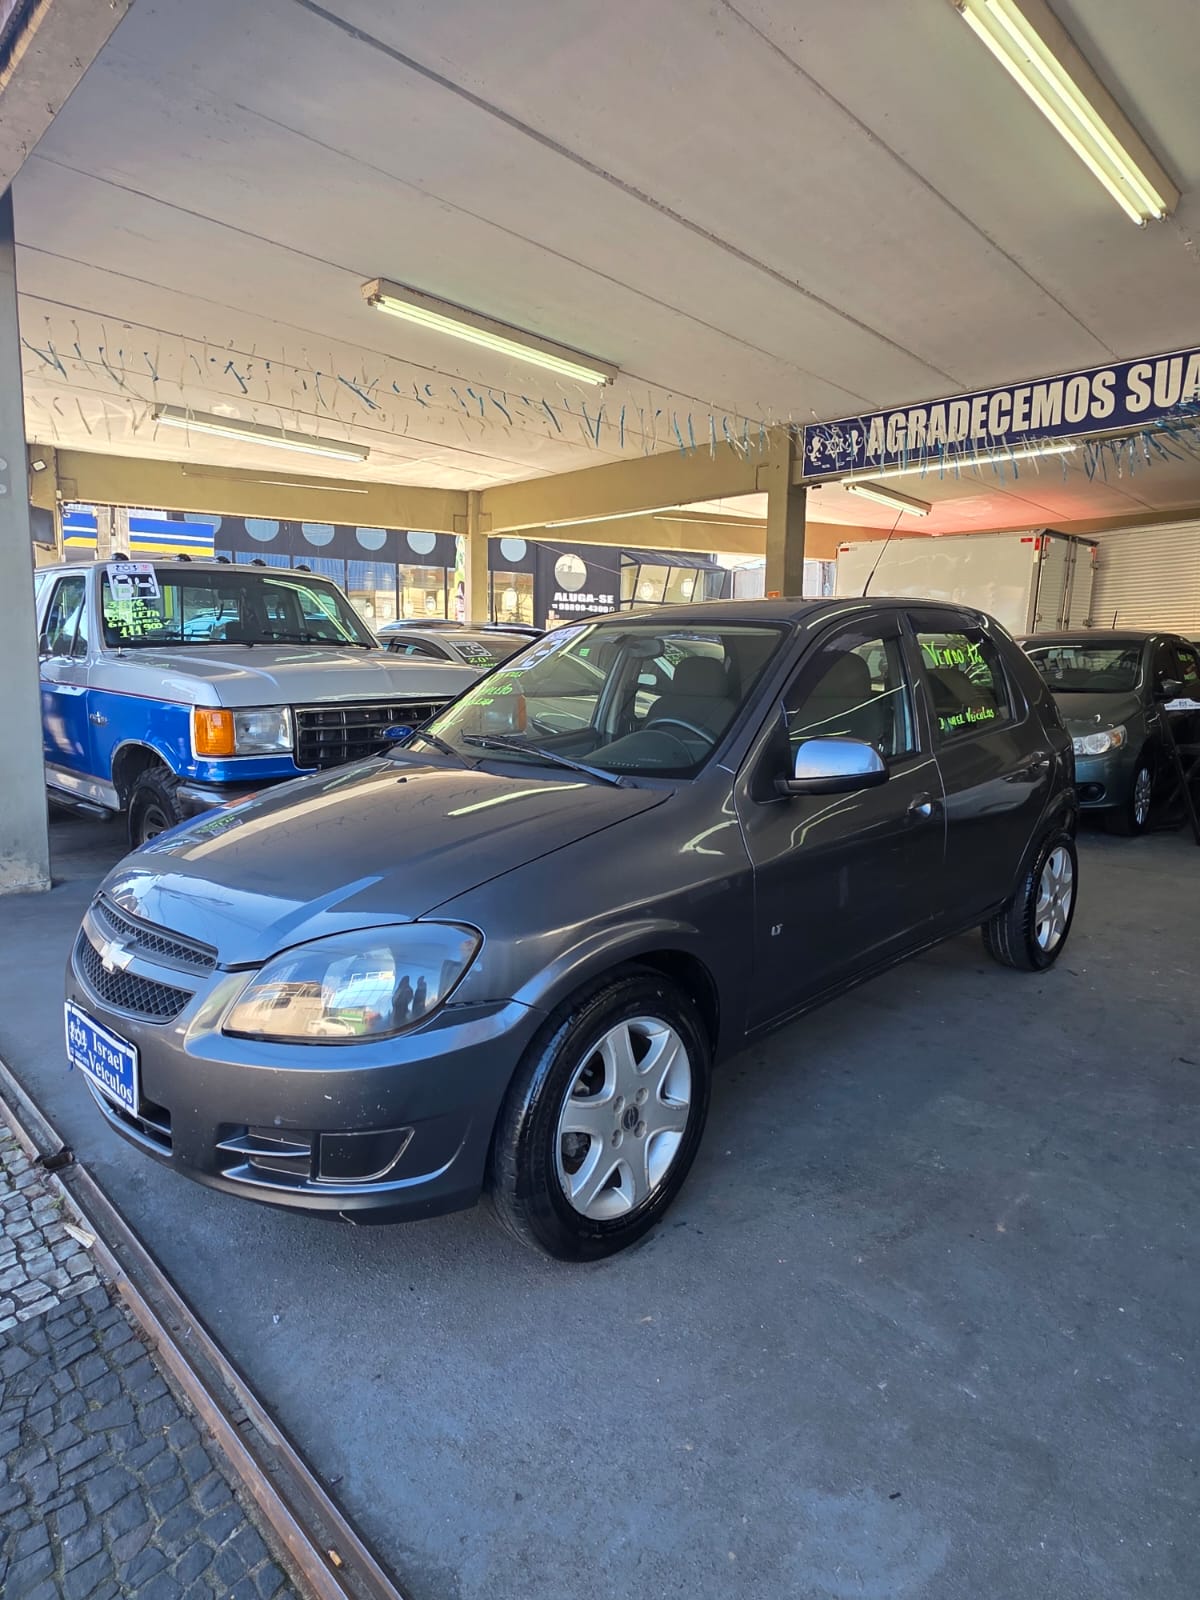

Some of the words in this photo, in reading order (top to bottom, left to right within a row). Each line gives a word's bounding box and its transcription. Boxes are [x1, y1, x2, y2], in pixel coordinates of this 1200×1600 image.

[865, 370, 1117, 457] AGRADECEMOS
[553, 592, 615, 604] ALUGA-SE
[92, 1031, 124, 1074] Israel
